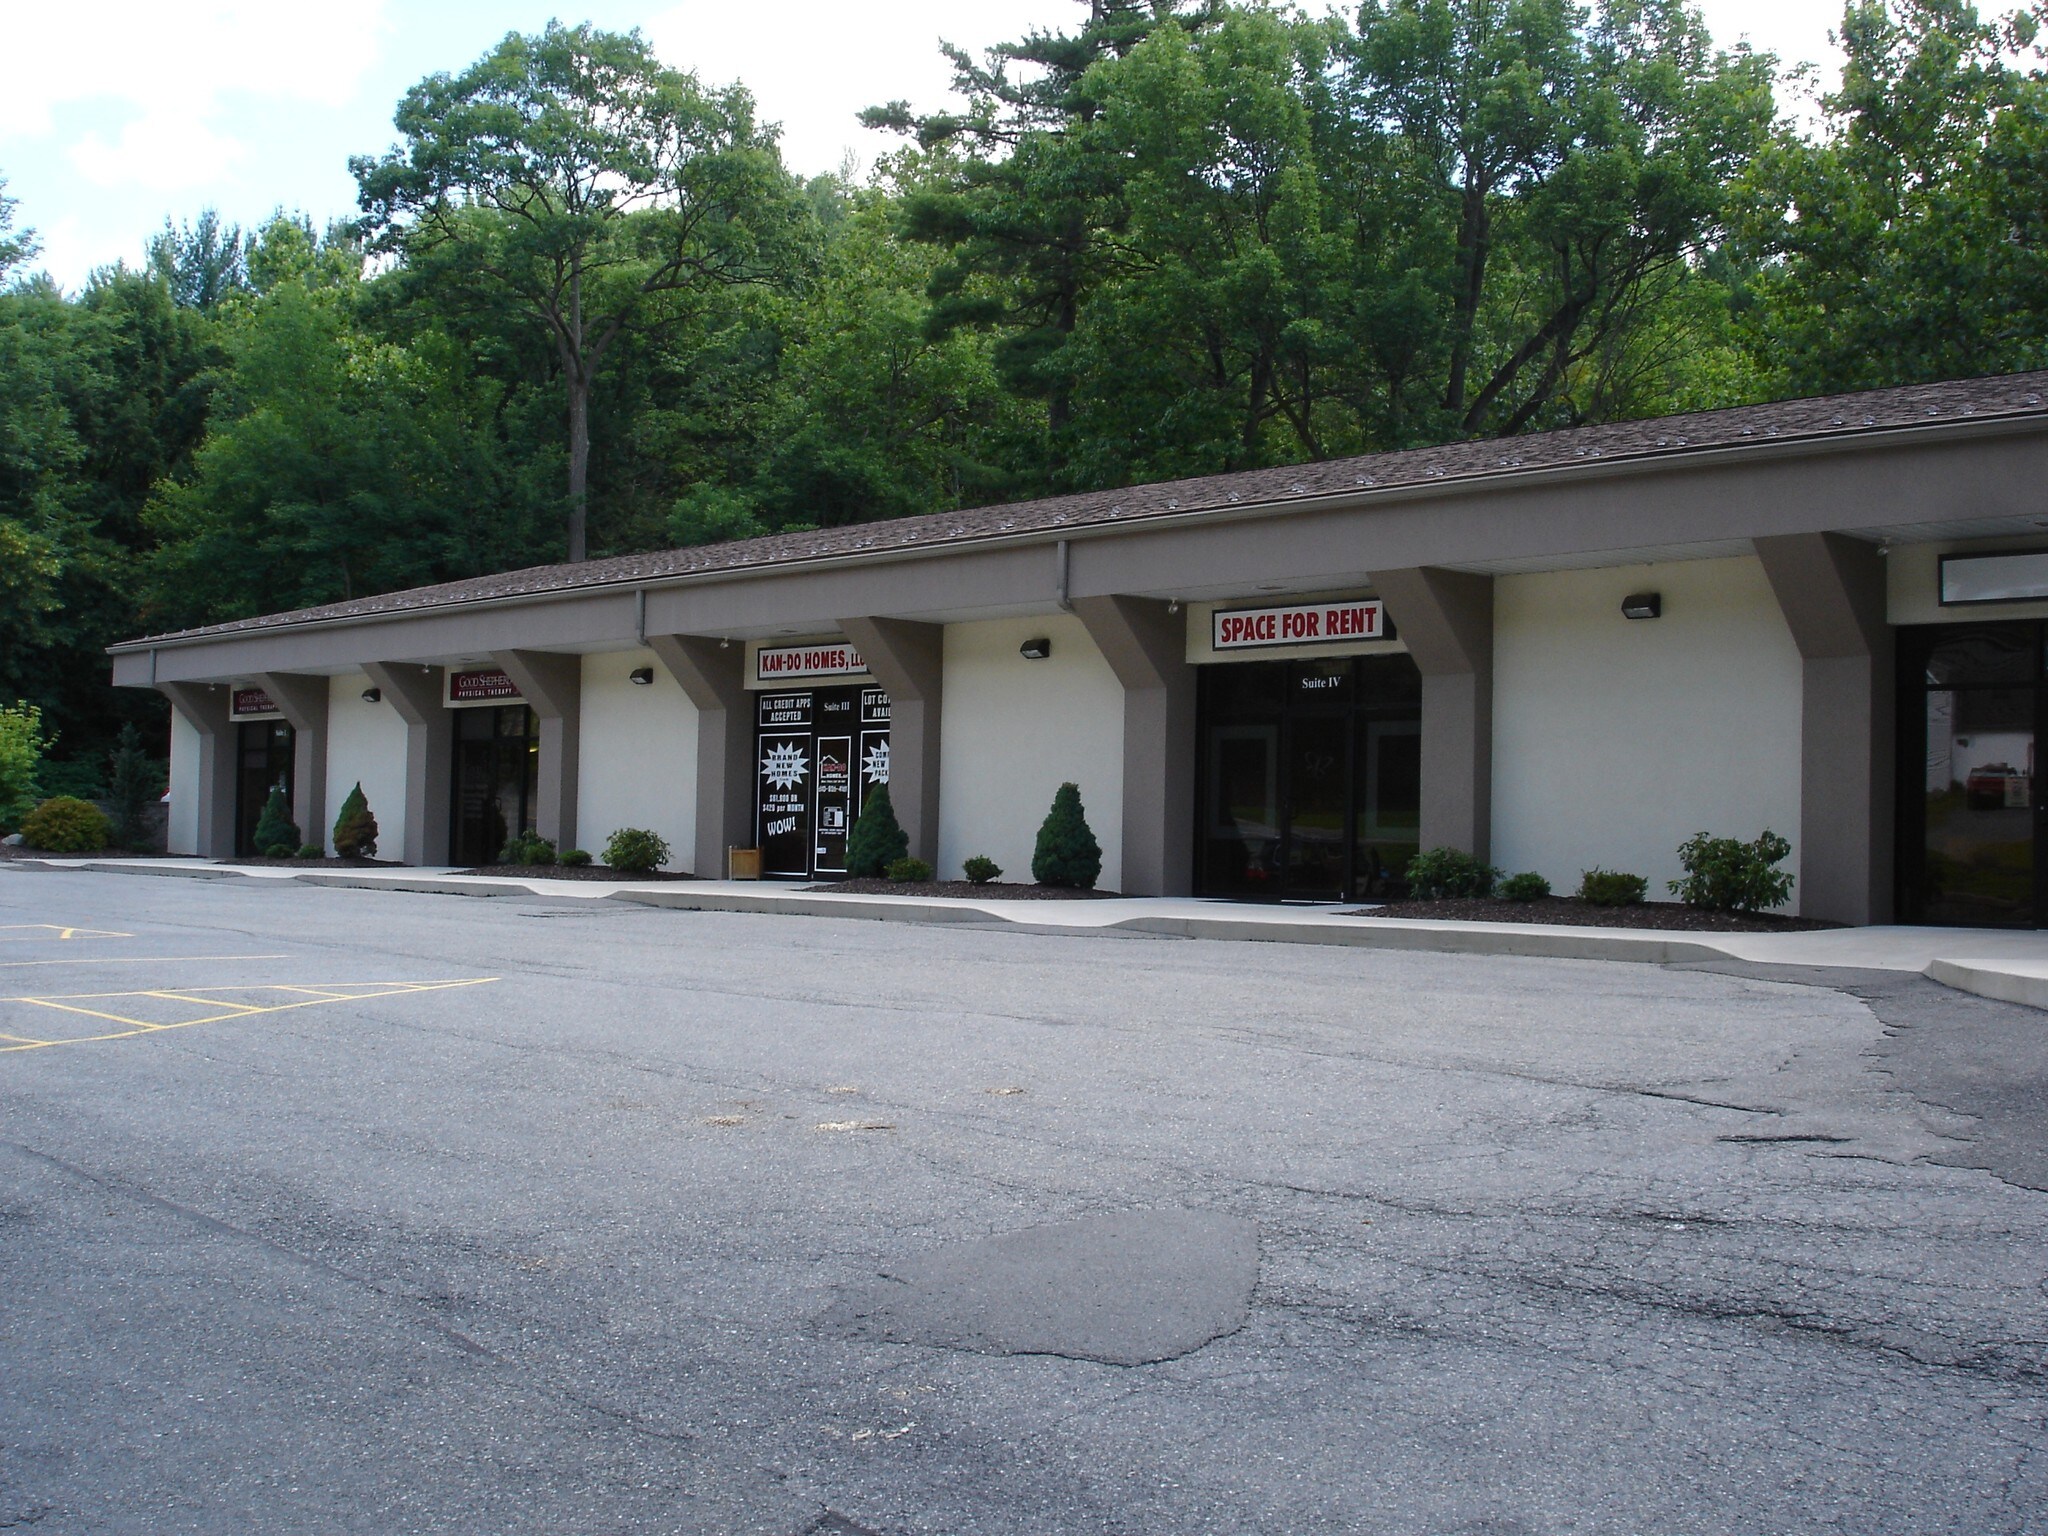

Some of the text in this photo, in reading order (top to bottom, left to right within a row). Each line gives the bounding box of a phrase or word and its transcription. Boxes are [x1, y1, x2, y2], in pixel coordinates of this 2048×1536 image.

[1221, 606, 1377, 643] SPACE FOR RENT
[762, 653, 801, 672] KAN-DO
[804, 650, 848, 671] HOMES,
[1302, 677, 1341, 689] Suite IV
[458, 689, 485, 697] PHYSICAL
[762, 698, 811, 710] ALL CREDIT APPS
[864, 695, 876, 706] LOT
[823, 702, 841, 712] Suite
[770, 711, 802, 722] ACCEPTED
[872, 760, 886, 768] NEW
[767, 816, 797, 837] WOW!
